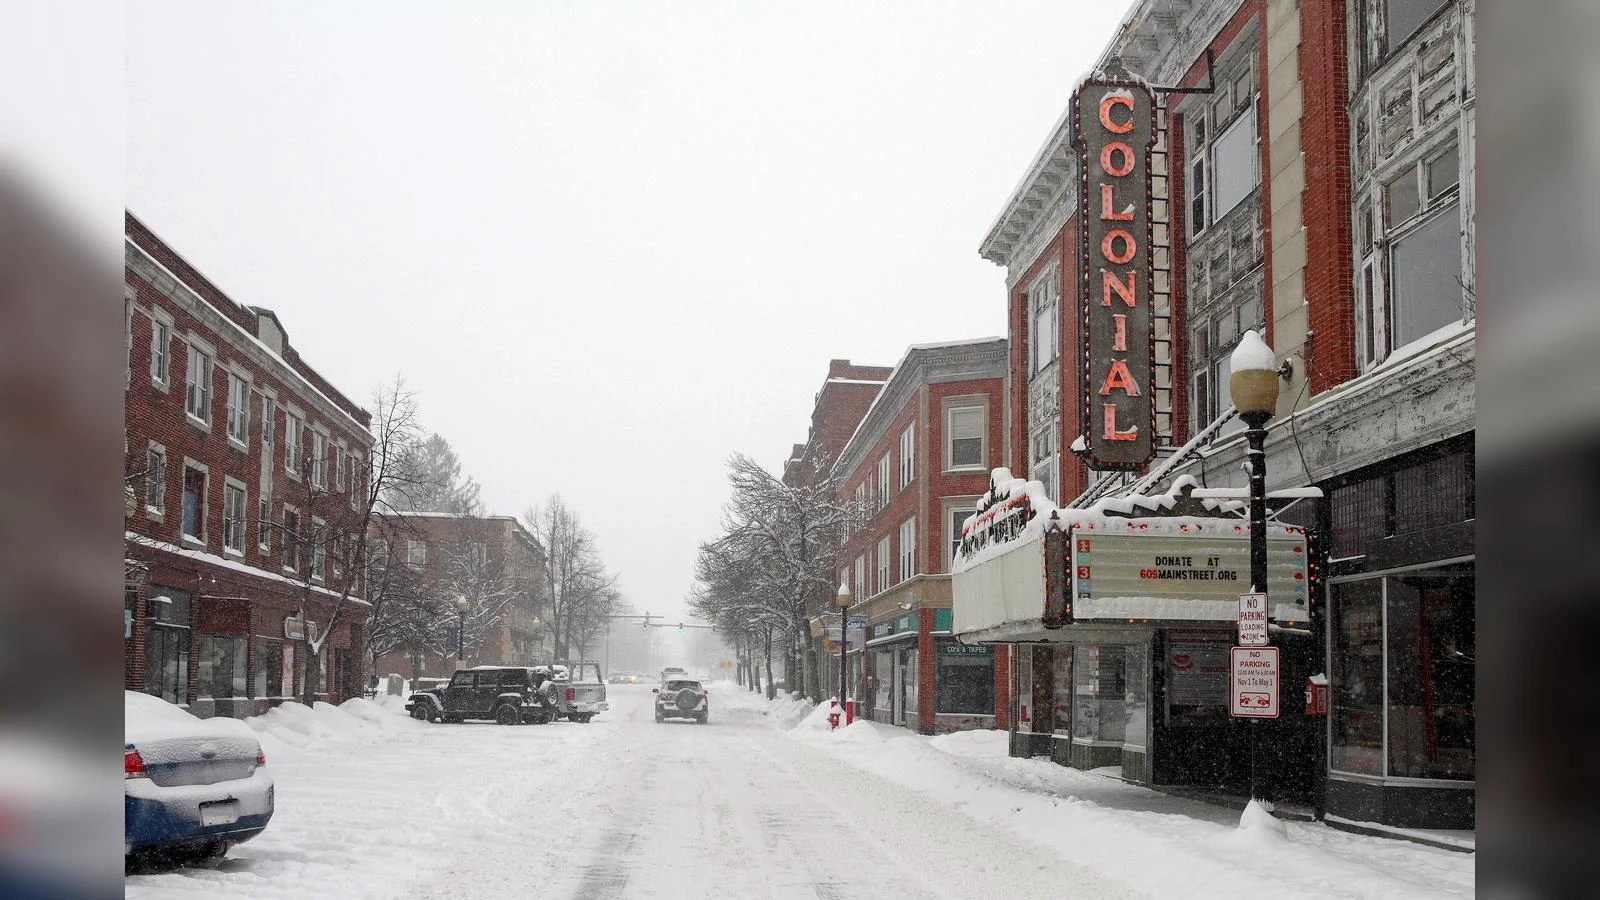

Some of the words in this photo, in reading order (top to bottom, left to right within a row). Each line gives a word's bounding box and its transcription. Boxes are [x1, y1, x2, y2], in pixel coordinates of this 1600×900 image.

[1099, 94, 1140, 442] COLONIAL
[1155, 556, 1192, 567] DONATE
[1207, 557, 1220, 567] AT
[1080, 567, 1089, 578] 3
[1247, 599, 1258, 608] NO
[1240, 611, 1265, 620] PARKING
[1248, 678, 1251, 686] 1
[1252, 678, 1258, 686] To
[1259, 679, 1268, 688] May
